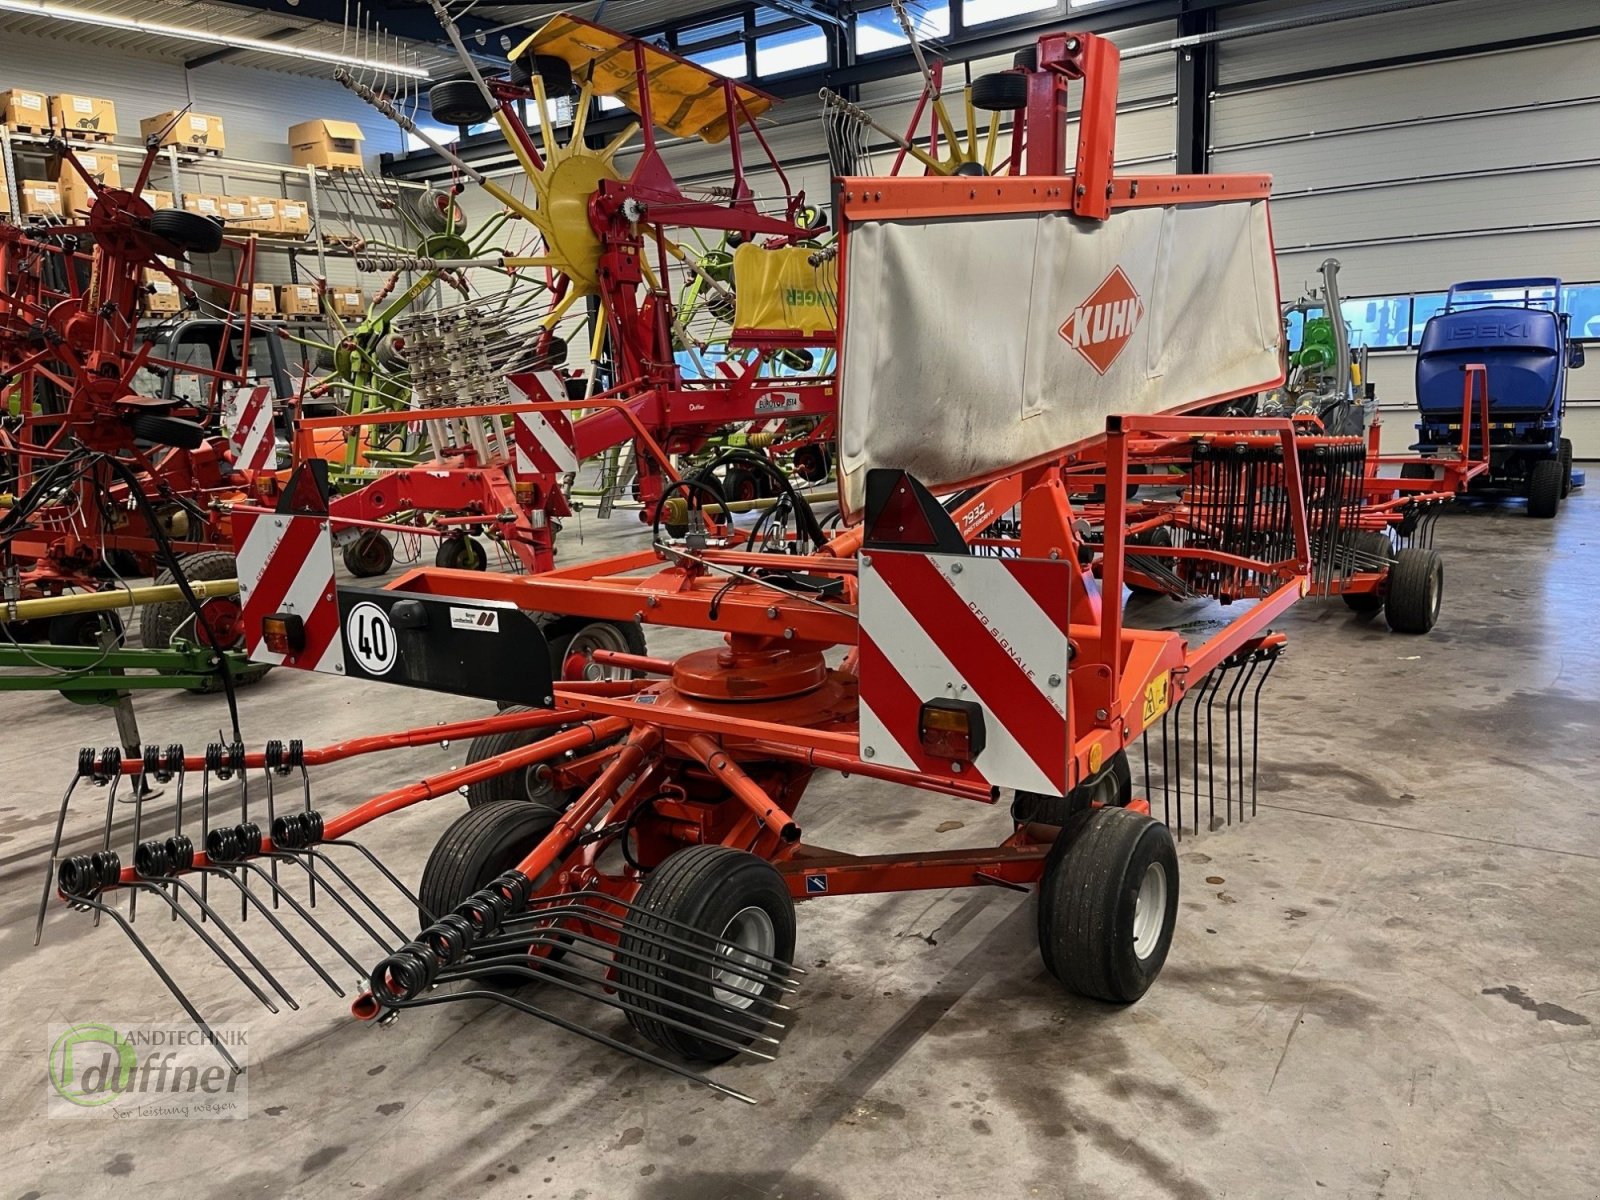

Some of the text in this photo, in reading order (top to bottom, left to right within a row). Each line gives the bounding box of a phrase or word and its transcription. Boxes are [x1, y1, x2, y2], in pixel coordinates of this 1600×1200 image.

[1071, 296, 1140, 349] KUHN
[1447, 323, 1531, 341] ISEKI
[962, 502, 986, 527] 7932
[968, 601, 990, 625] CFG
[358, 614, 388, 662] 40
